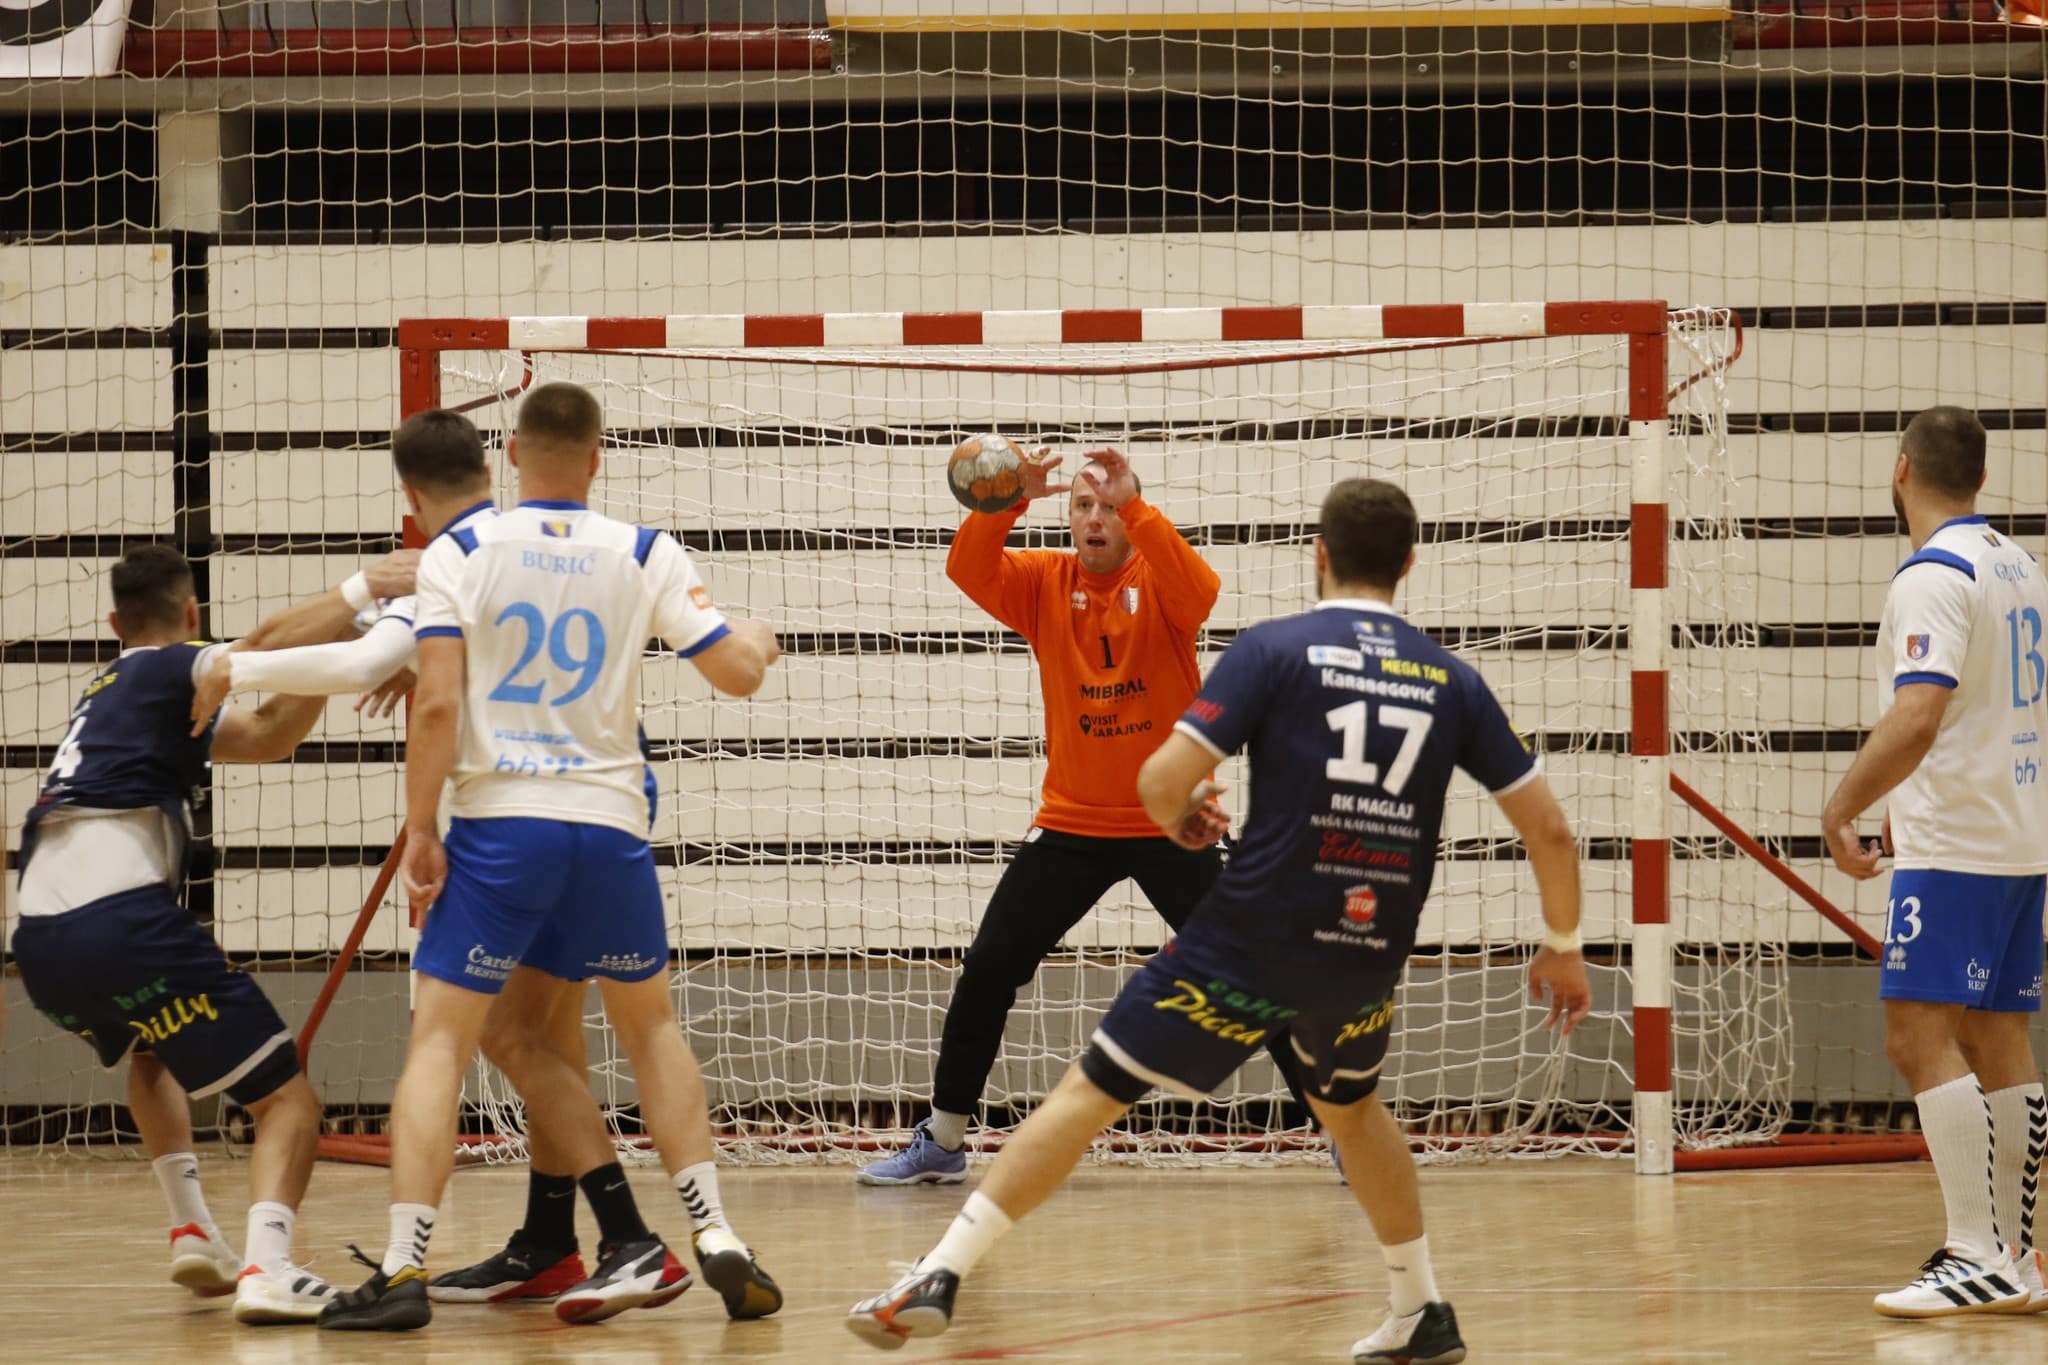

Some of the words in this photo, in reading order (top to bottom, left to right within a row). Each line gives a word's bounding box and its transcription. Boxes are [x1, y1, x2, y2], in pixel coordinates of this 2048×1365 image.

[521, 550, 596, 576] BURIĆ
[487, 601, 606, 707] 29
[1099, 635, 1116, 669] 1
[2006, 606, 2045, 708] 13
[1380, 658, 1422, 678] MEGA
[1080, 678, 1147, 700] MIBRAL
[1091, 714, 1119, 726] VISIT
[1092, 720, 1152, 738] SARAJEVO
[1325, 700, 1434, 797] 17
[1331, 793, 1354, 811] RK
[1356, 796, 1415, 821] MAGLAJ
[1345, 897, 1376, 913] STOP
[1885, 896, 1922, 945] 13
[1154, 979, 1267, 1045] Picca
